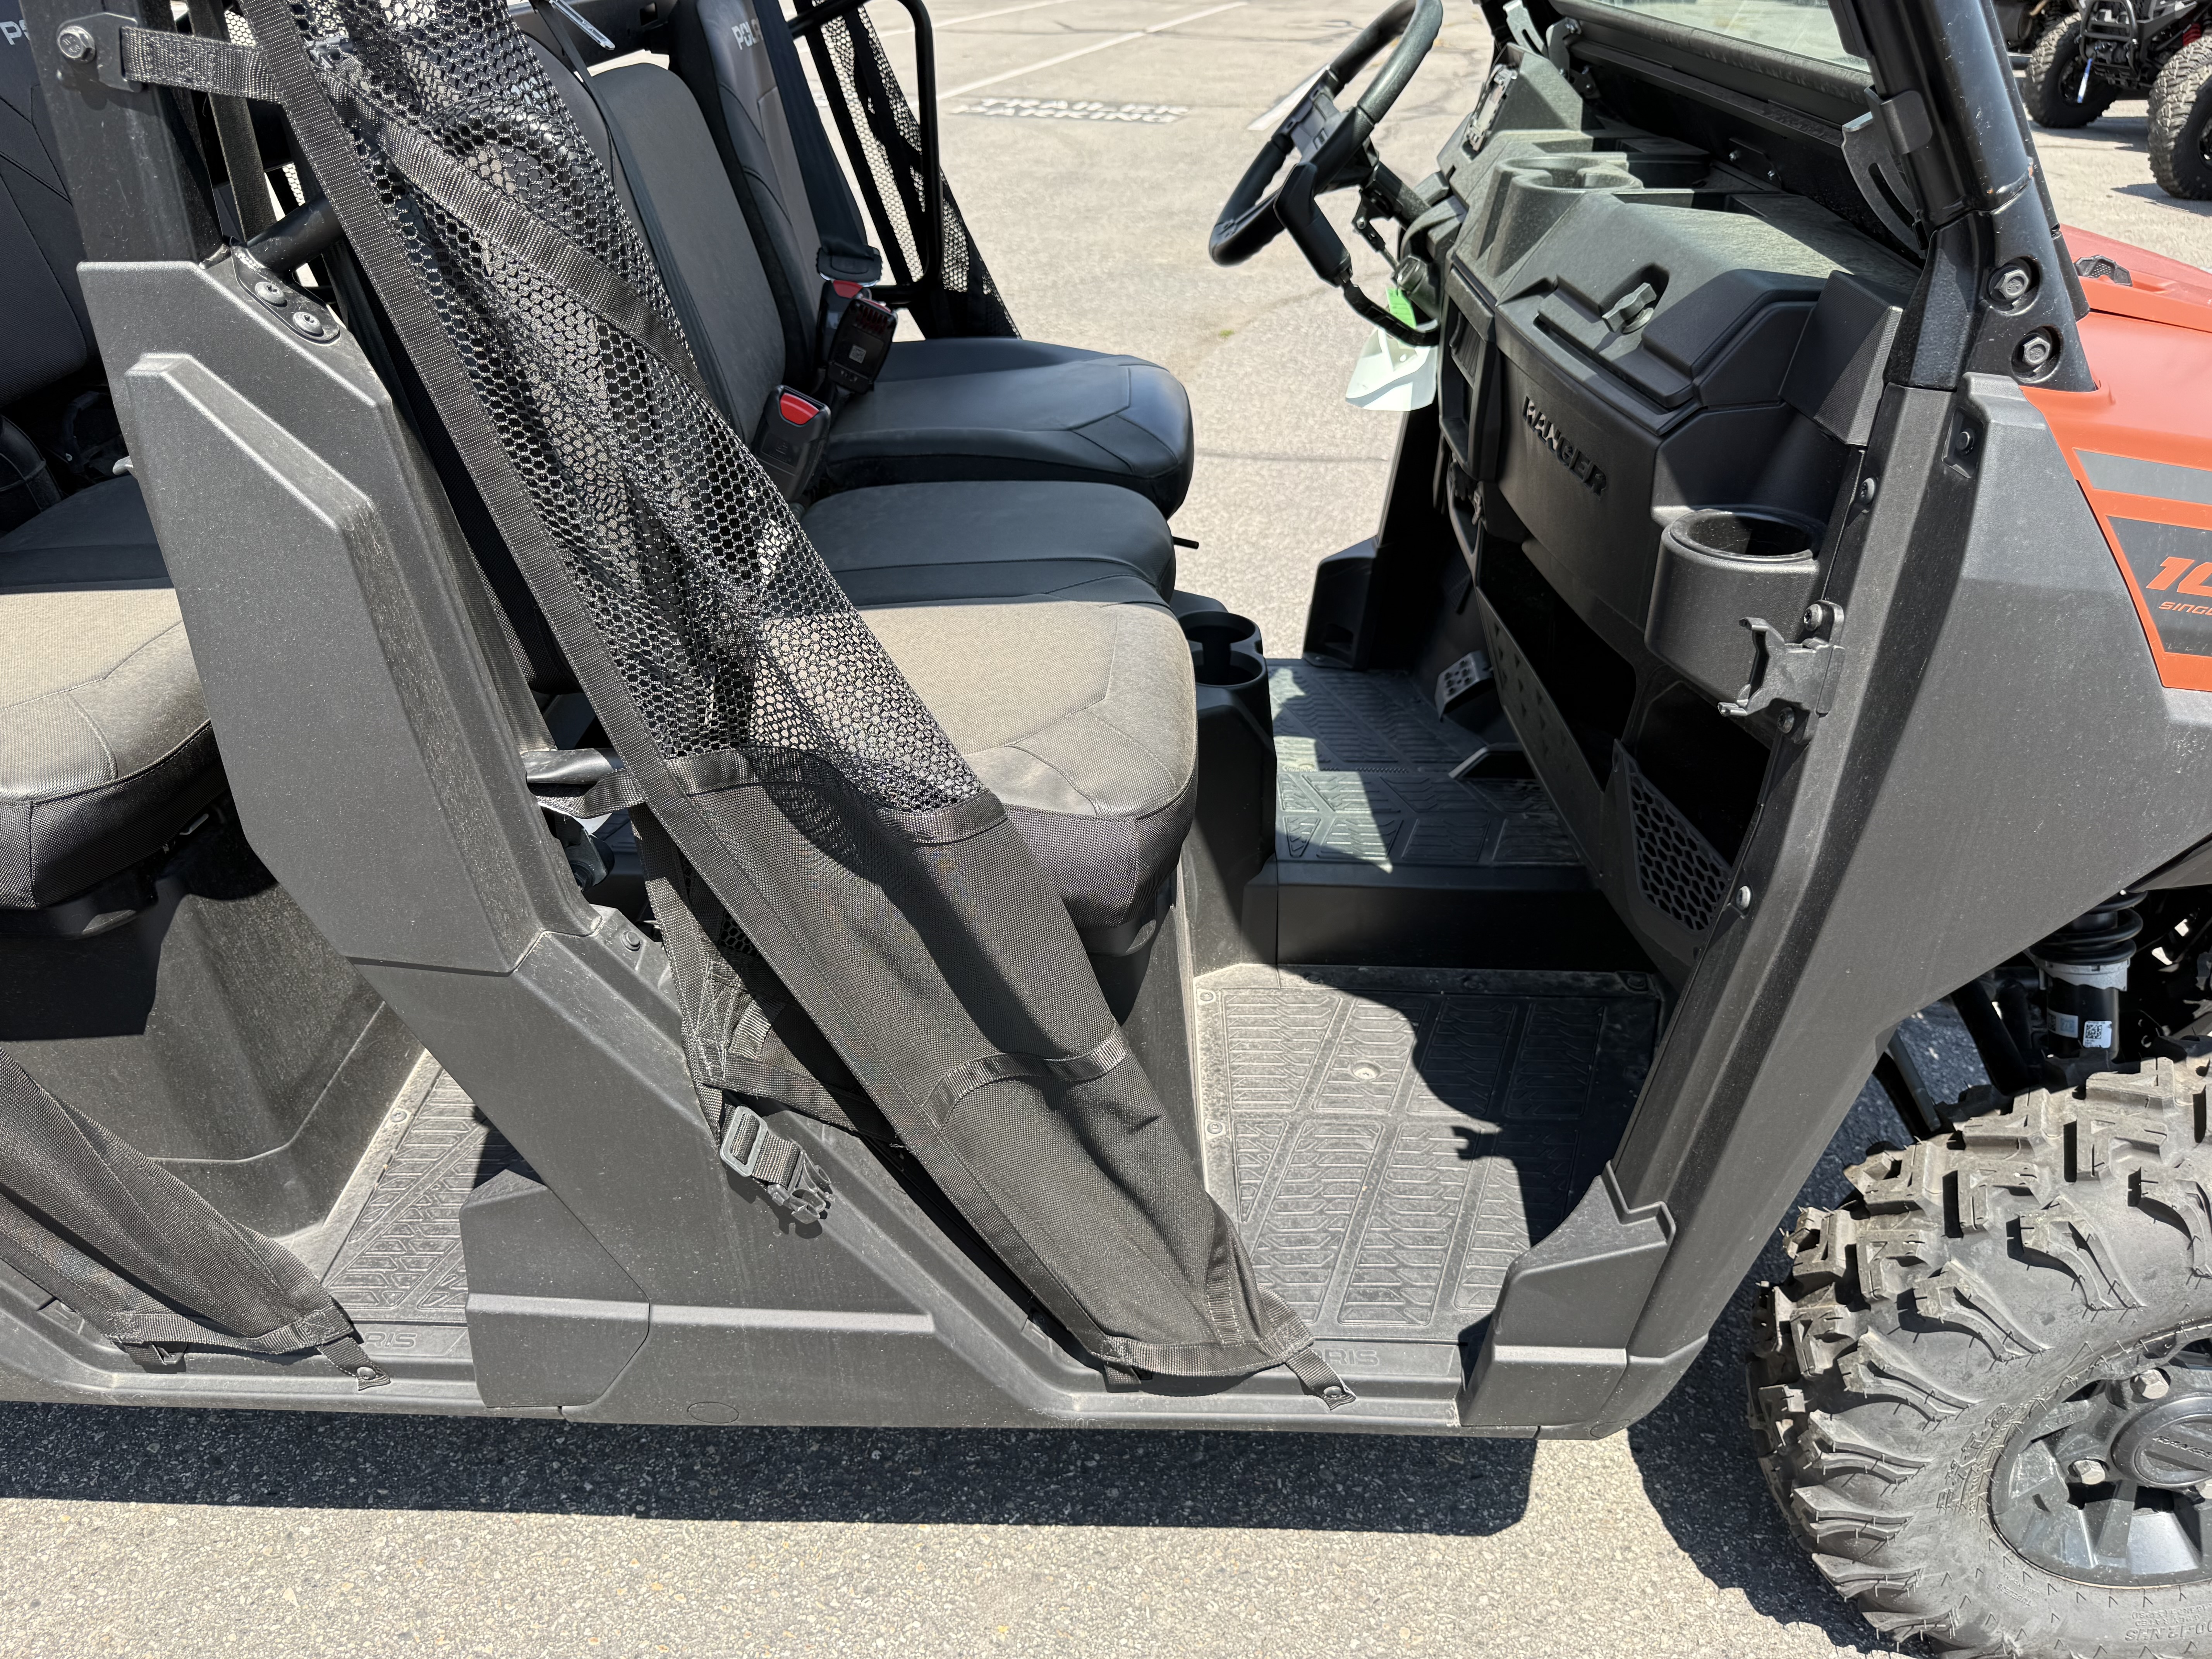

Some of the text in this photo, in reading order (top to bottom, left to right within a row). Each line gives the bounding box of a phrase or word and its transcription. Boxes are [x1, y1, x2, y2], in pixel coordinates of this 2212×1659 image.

[951, 105, 1177, 123] PARKING
[981, 98, 1189, 115] TRAILER
[1522, 396, 1607, 500] RANGER
[1997, 1583, 2032, 1606] TUBELESS
[2124, 1626, 2166, 1641] NHS
